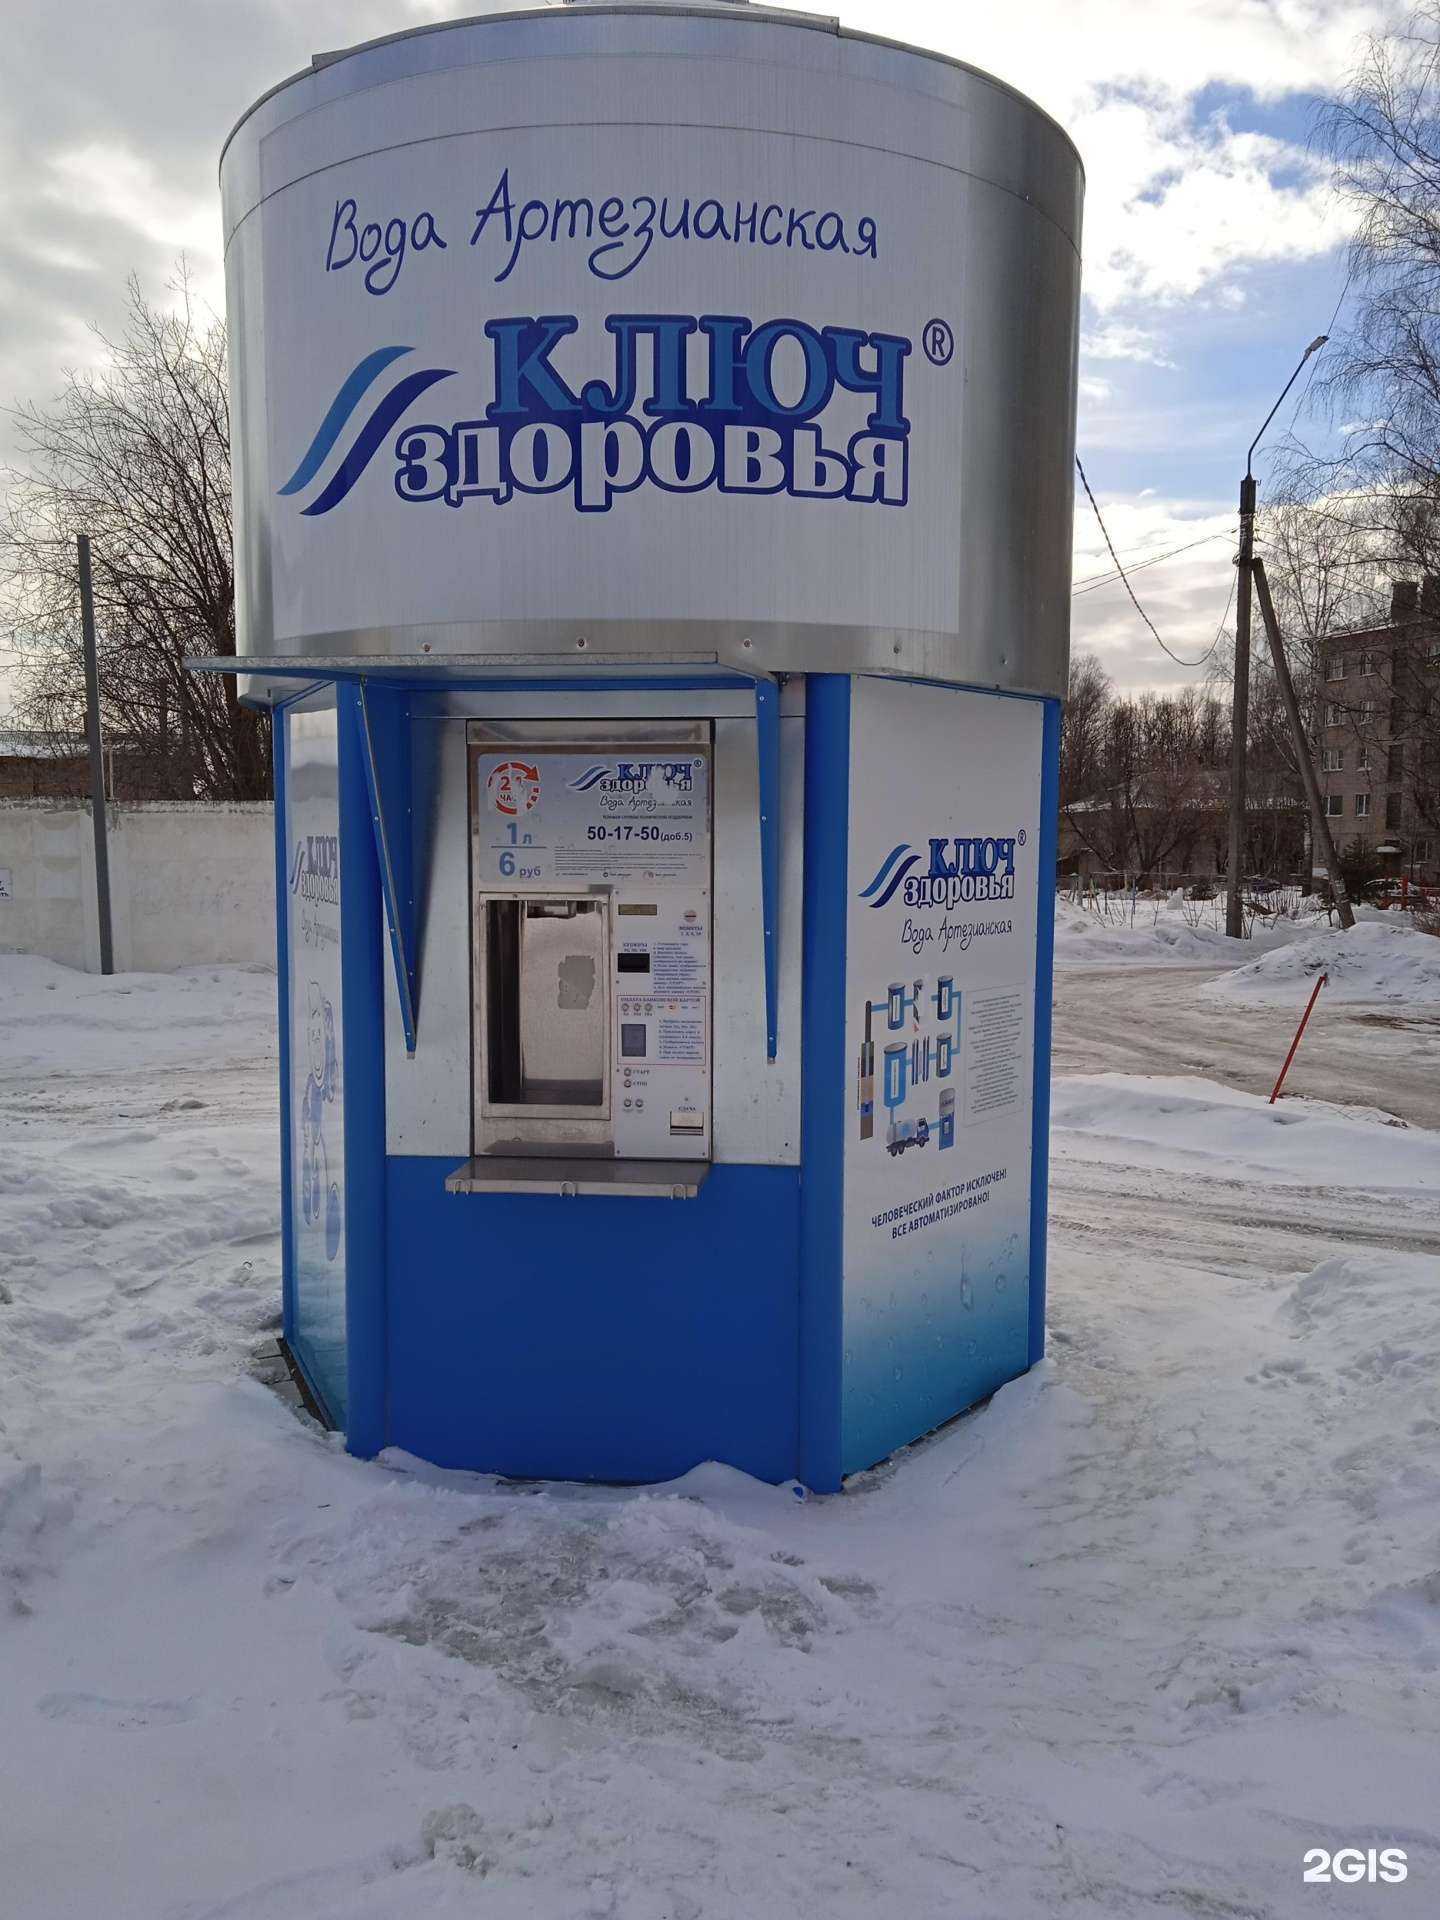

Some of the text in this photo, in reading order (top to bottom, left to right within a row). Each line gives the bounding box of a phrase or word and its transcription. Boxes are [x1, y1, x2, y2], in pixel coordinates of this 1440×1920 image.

[326, 168, 879, 295] Вода Артезианская
[506, 822, 517, 844] 1
[499, 852, 541, 879] 6 руб
[902, 916, 1012, 954] Вода Артезианская
[871, 1168, 1007, 1228] ЧЕЛОВЕЧЕСКИЙ ФАКТОР ИСКЛЮЧЕН!
[891, 1191, 990, 1239] ВСЕ АВТОМАТИЗИРОВАНО!
